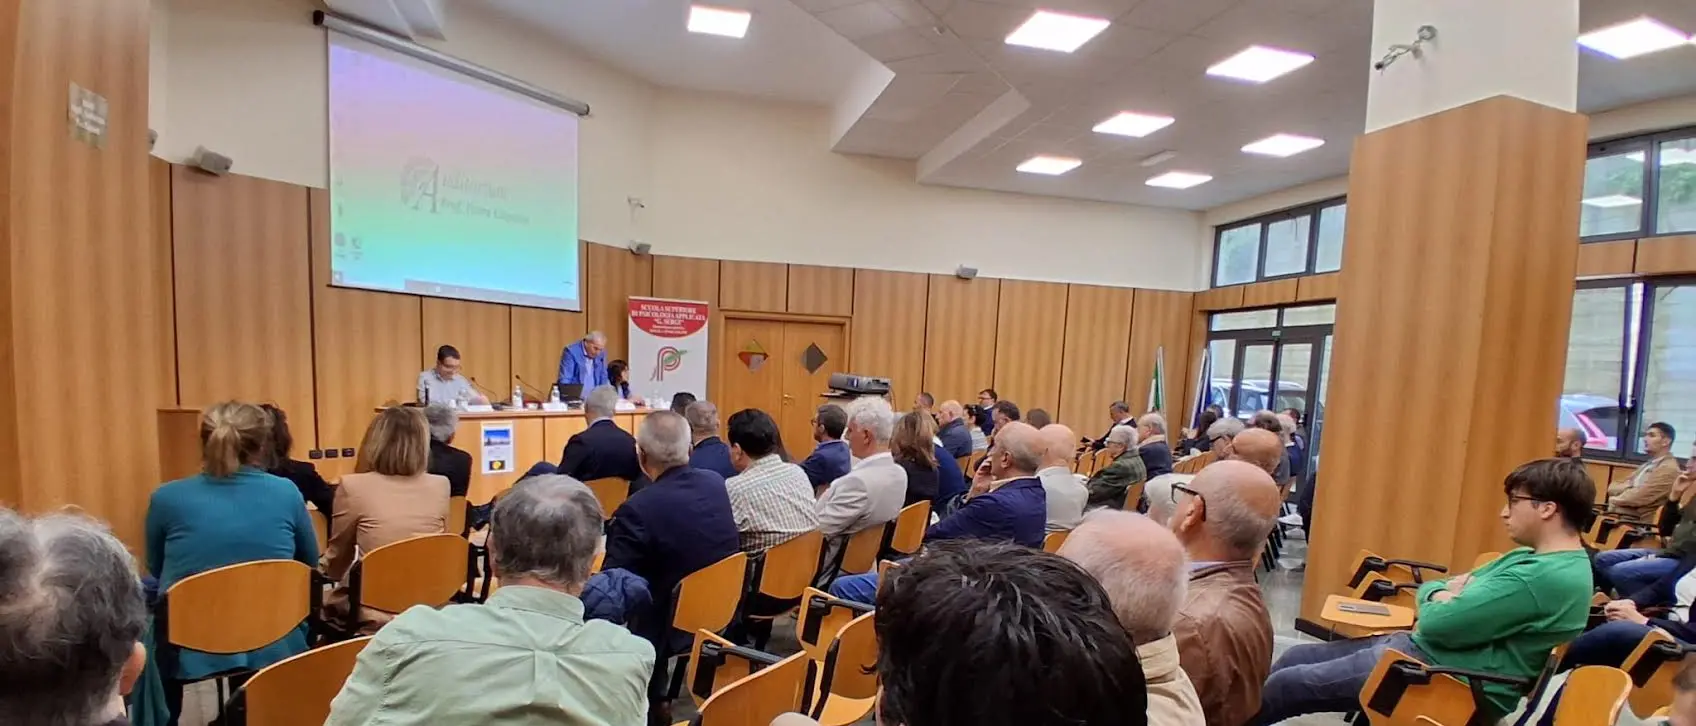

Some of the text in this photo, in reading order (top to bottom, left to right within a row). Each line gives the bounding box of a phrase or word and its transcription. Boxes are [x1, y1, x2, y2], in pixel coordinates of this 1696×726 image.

[665, 305, 696, 313] SUPERIORE
[639, 310, 674, 318] PSICOLOGIA
[675, 312, 705, 320] APPLICATA
